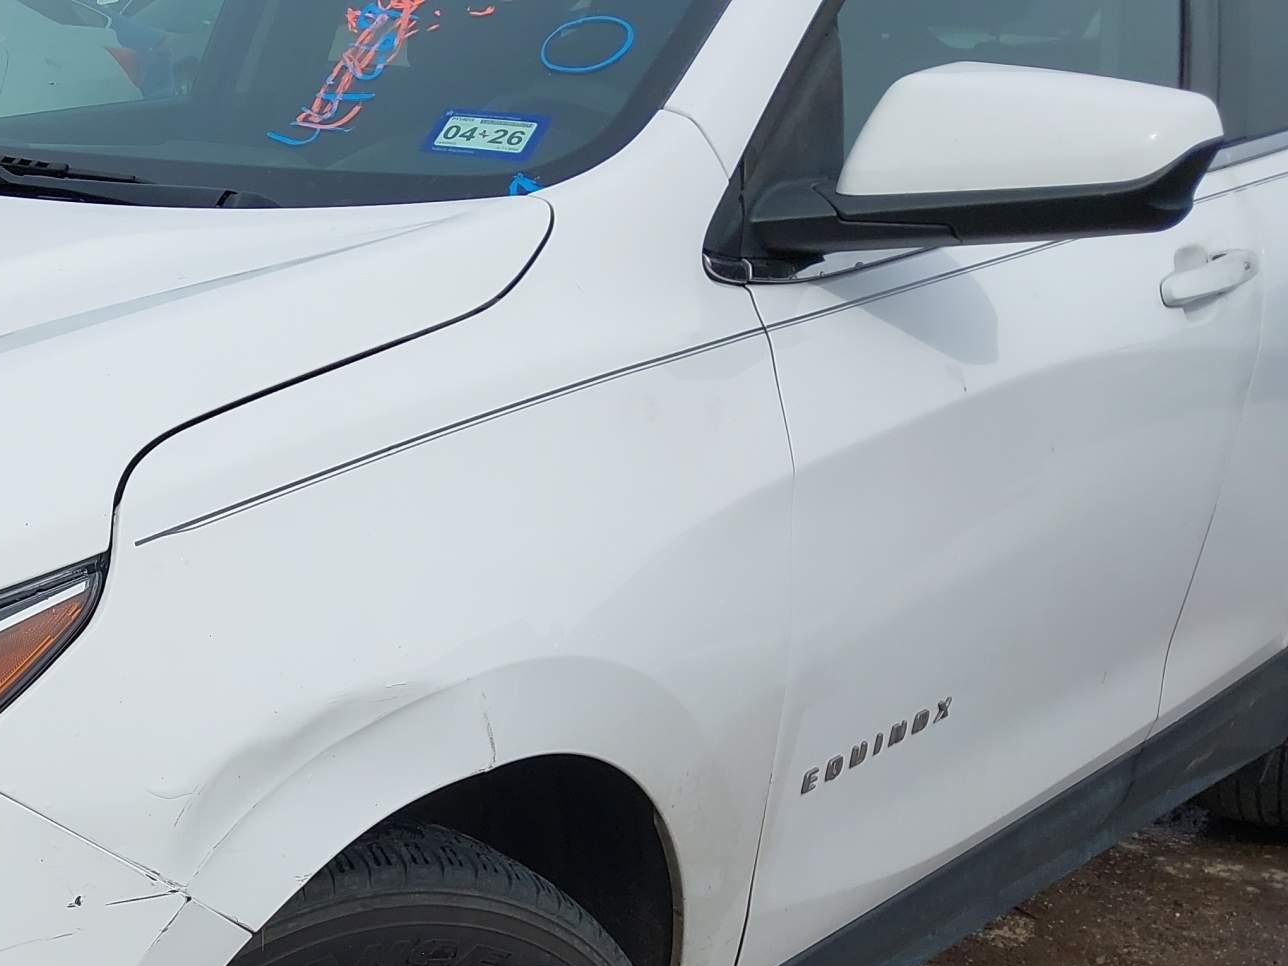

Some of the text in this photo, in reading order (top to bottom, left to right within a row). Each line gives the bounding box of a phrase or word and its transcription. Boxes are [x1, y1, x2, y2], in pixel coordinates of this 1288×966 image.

[442, 125, 526, 146] 04 26
[800, 696, 953, 796] EQUINOX
